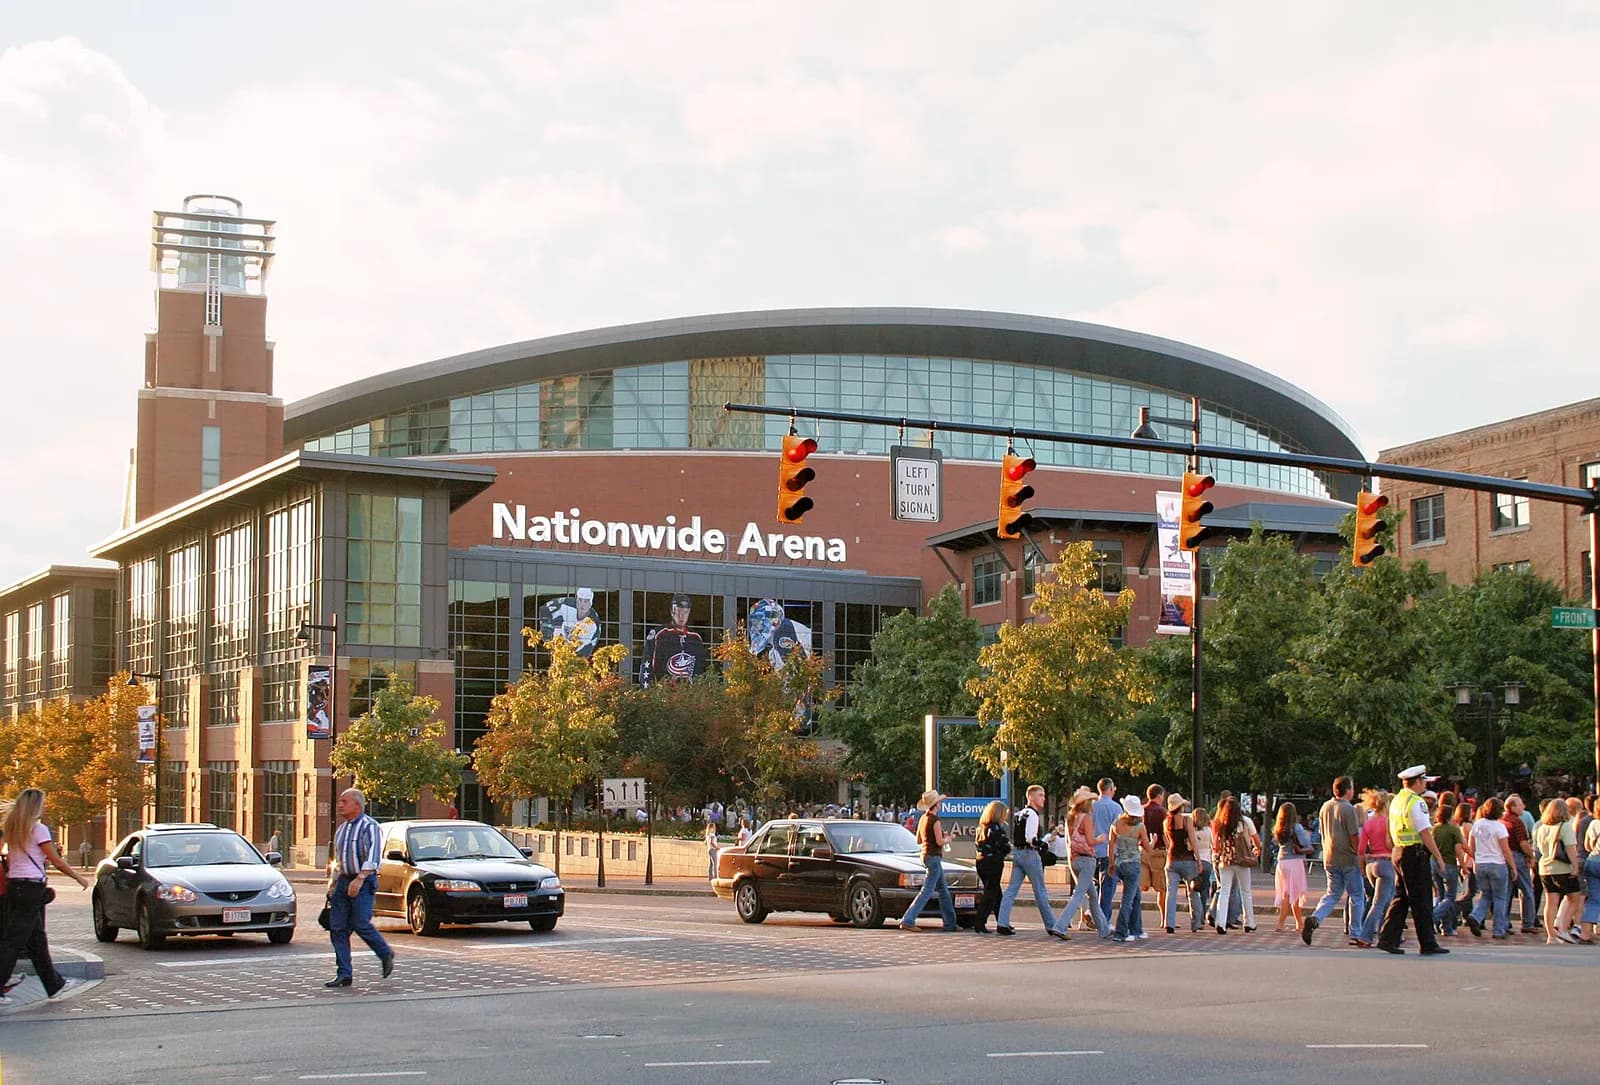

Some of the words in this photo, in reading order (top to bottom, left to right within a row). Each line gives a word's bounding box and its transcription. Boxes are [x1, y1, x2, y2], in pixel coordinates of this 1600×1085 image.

[905, 466, 928, 479] LEFT
[905, 483, 930, 497] TURN
[900, 501, 935, 515] SIGNAL
[492, 502, 725, 554] Nationwide
[736, 522, 847, 563] Arena
[1560, 611, 1587, 625] FRONT
[950, 821, 977, 836] Are
